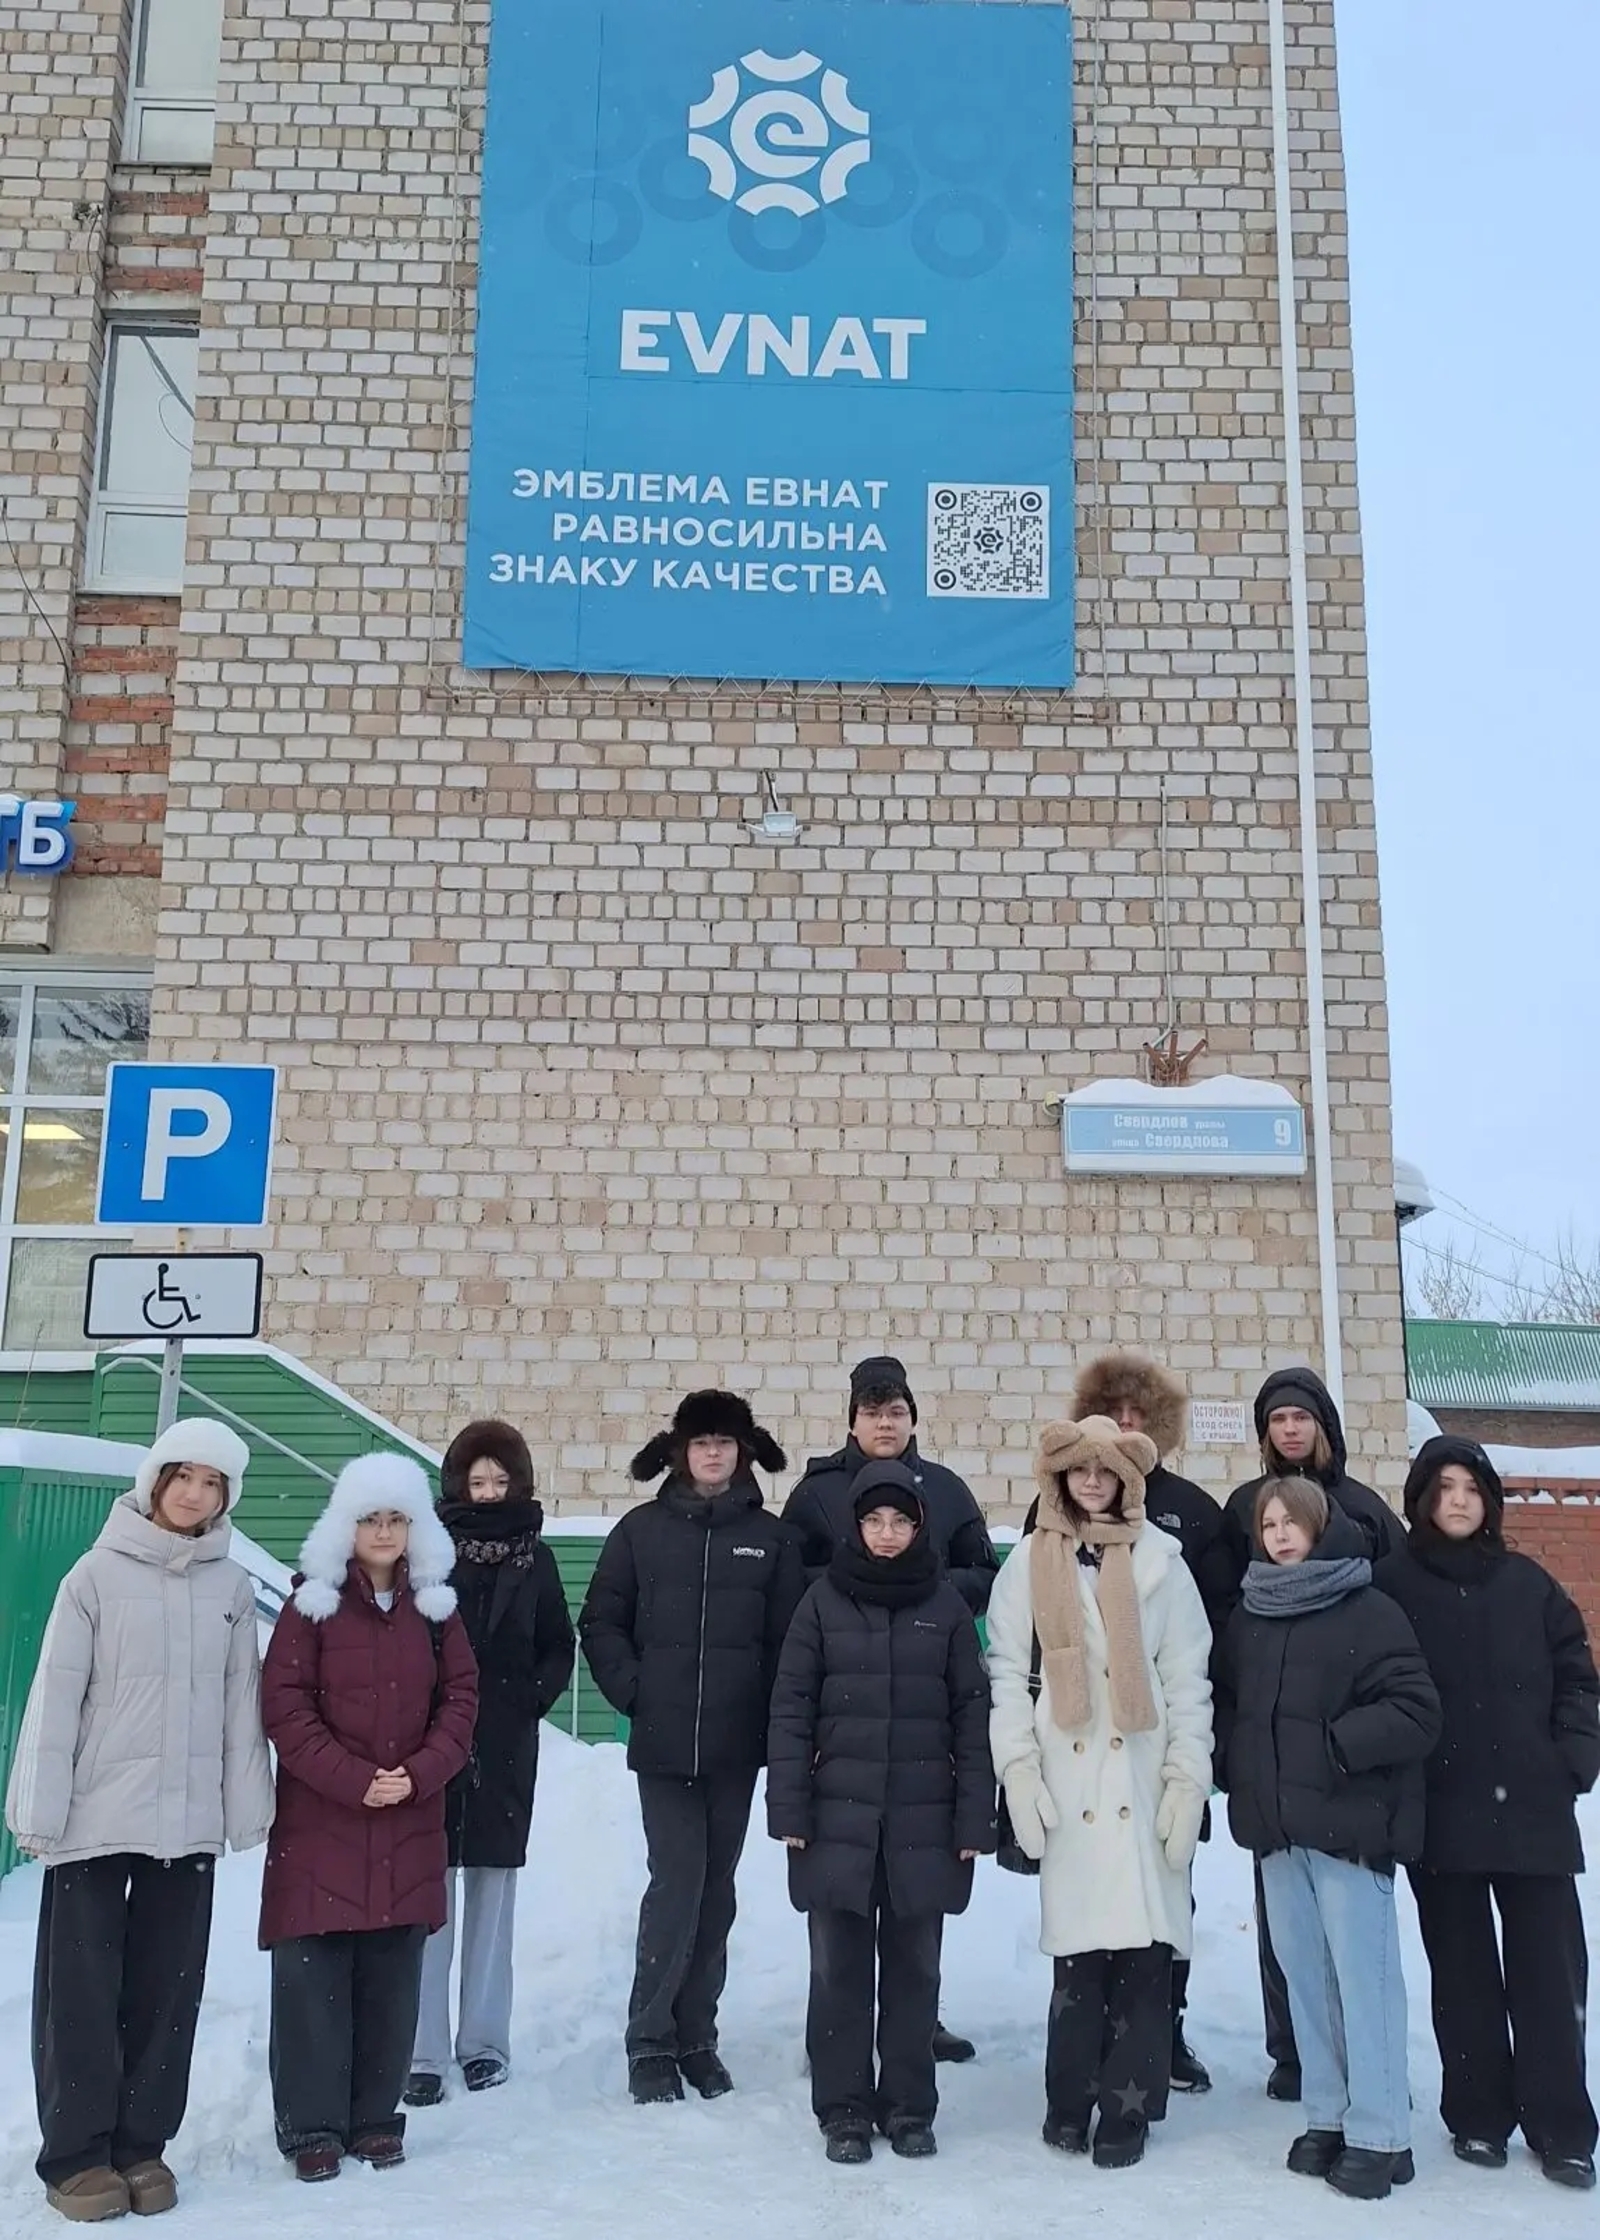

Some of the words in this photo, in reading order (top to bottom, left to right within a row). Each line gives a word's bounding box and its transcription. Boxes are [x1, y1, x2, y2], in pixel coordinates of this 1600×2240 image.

[620, 309, 927, 380] EVNAT
[512, 468, 731, 505] ЭМБЛЕМА
[746, 477, 889, 509] ЕВНАТ
[553, 512, 887, 552] РАВНОСИЛЬНА
[489, 553, 638, 587] ЗНАКУ
[653, 559, 887, 595] КАЧЕСТВА
[141, 1088, 232, 1201] P
[1145, 1132, 1229, 1149] Свердлова
[1273, 1118, 1292, 1147] 9
